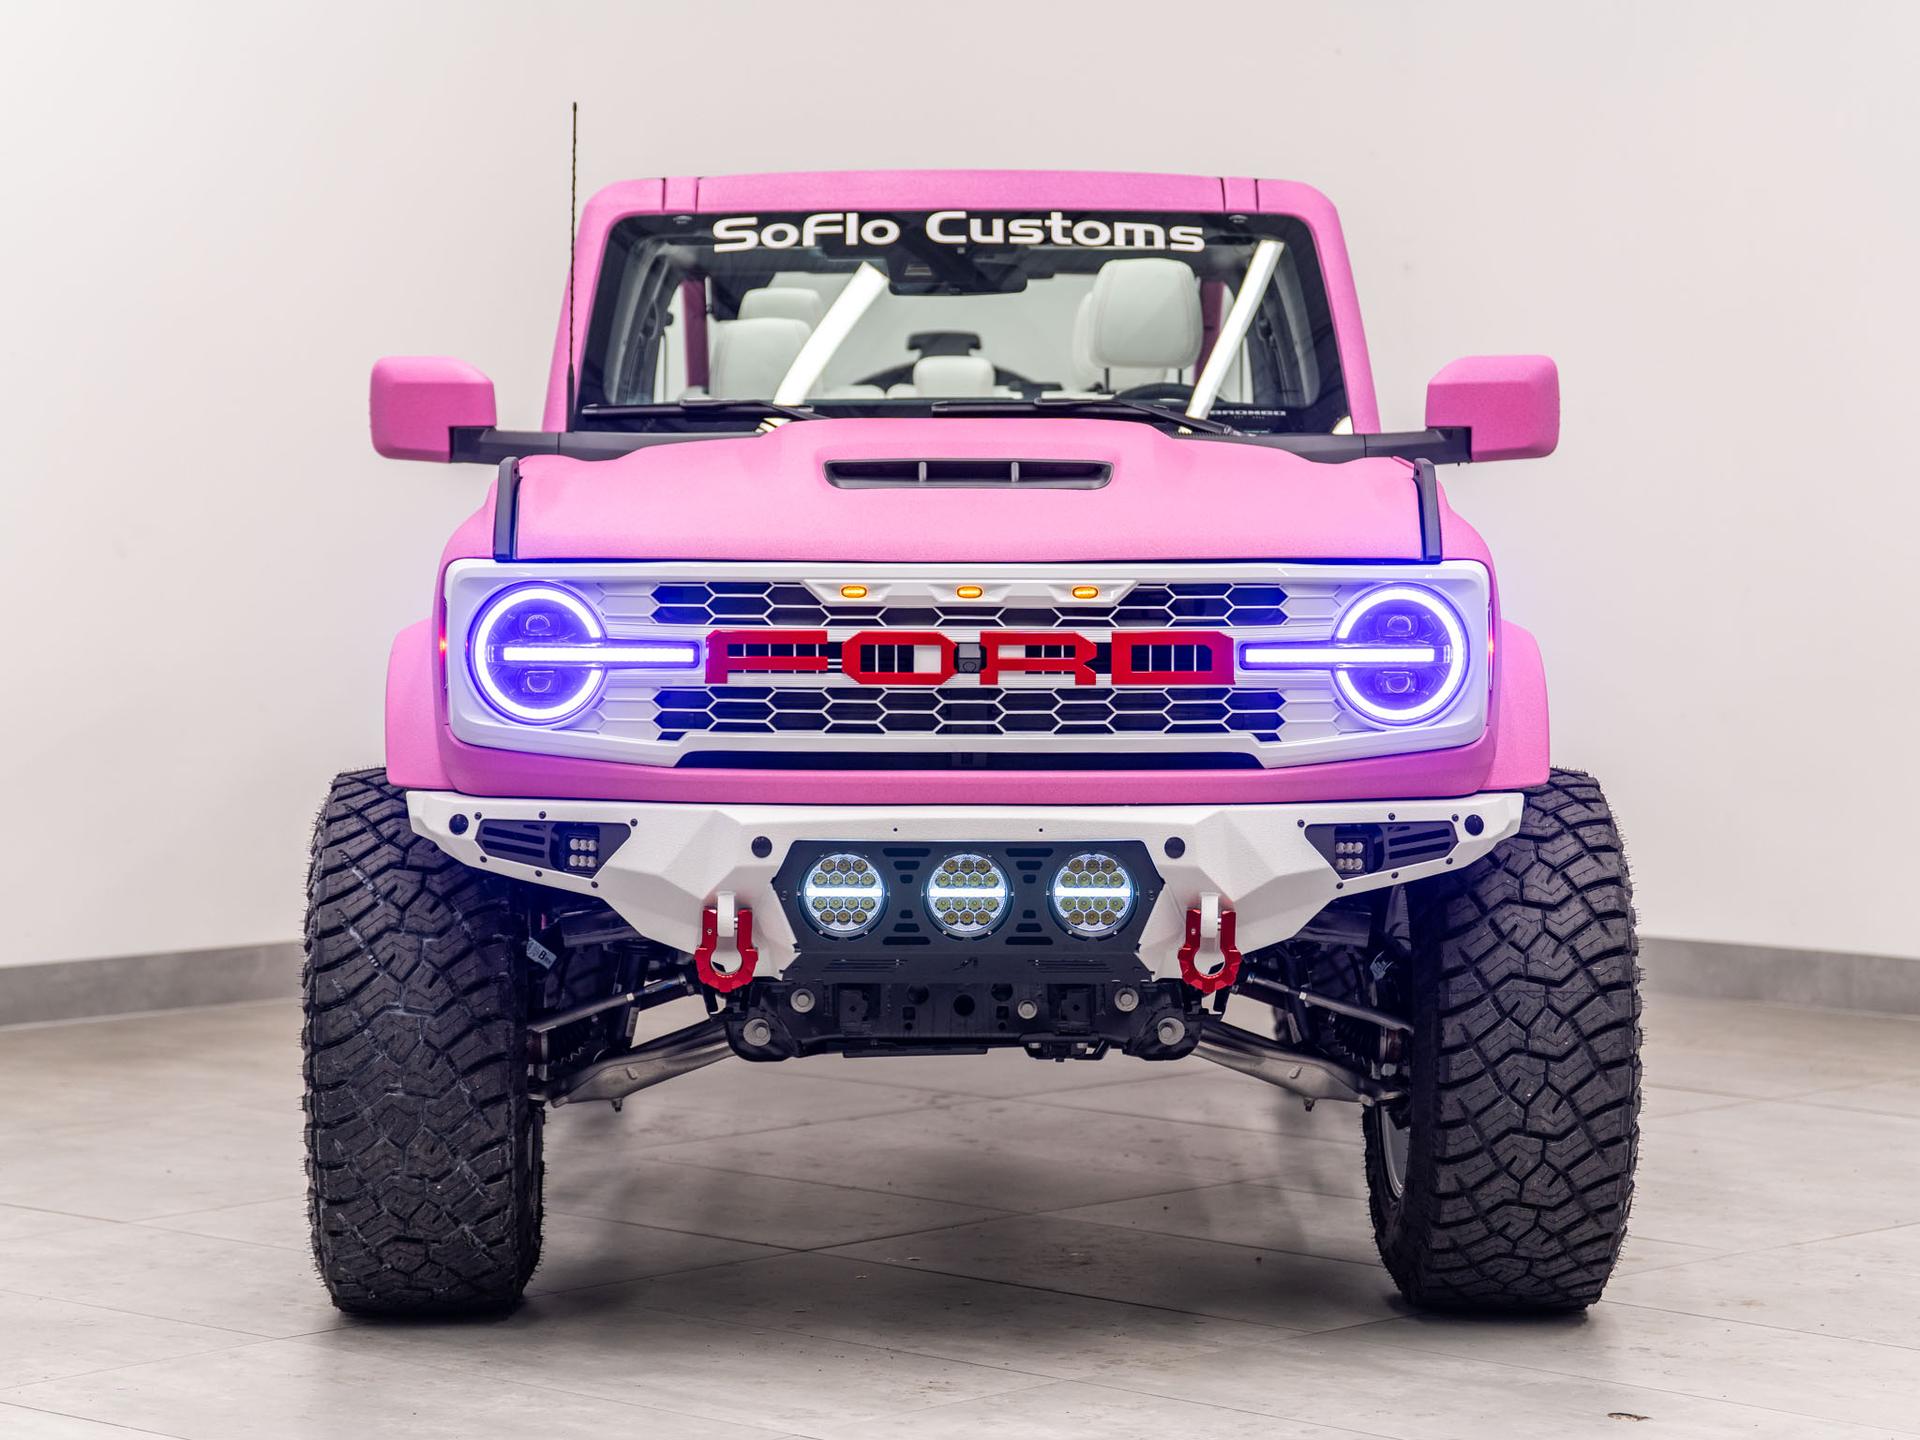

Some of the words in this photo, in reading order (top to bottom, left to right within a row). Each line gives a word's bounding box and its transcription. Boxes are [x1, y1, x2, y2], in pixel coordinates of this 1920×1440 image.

[712, 212, 900, 253] SoFlo
[925, 211, 1205, 252] Customs
[705, 629, 1236, 686] FORD
